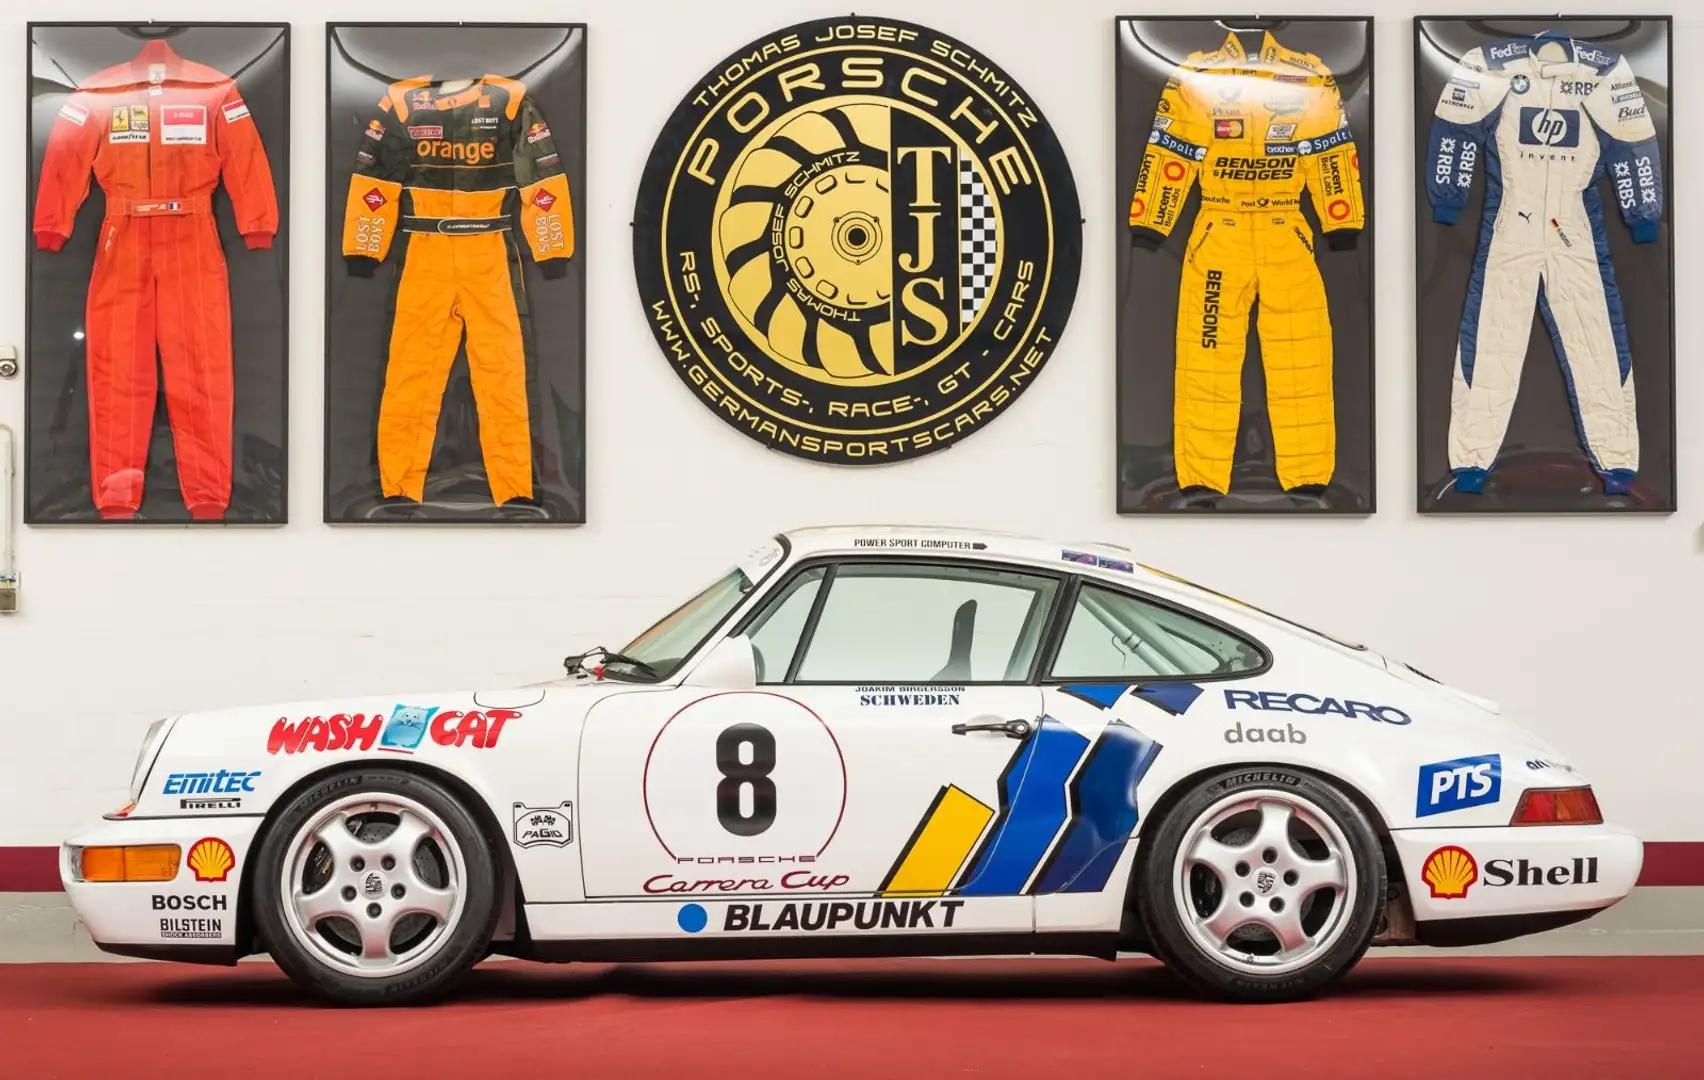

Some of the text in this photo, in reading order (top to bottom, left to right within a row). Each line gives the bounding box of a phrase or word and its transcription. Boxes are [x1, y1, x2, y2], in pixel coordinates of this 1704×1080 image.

[1490, 43, 1528, 60] FedEx
[692, 25, 1039, 129] THOMAS JOSEF SCHMITZ
[1575, 82, 1600, 96] RB
[687, 57, 1033, 194] PORSCHE
[1618, 104, 1646, 118] Bud
[1314, 130, 1348, 150] Spalt
[1537, 108, 1564, 146] hp
[417, 140, 495, 165] orange
[1162, 134, 1195, 157] Spalt
[1460, 141, 1477, 172] RBS
[1136, 153, 1156, 194] Lucent
[1215, 157, 1297, 169] BENSON
[1220, 169, 1294, 180] HEDGES
[1329, 155, 1344, 195] Lucent
[1436, 154, 1453, 185] RBS
[1635, 156, 1655, 187] RBS
[1153, 186, 1173, 226] Lucent
[1617, 178, 1636, 209] RBS
[353, 216, 371, 252] LOST
[367, 216, 386, 253] BOYS
[535, 216, 550, 253] BOYS
[549, 213, 564, 249] LOST
[771, 150, 861, 323] THOMAS JOSEF SCHMITZ
[1201, 269, 1223, 349] BENSONS
[937, 361, 971, 395] GT
[992, 259, 1035, 341] CARS
[652, 300, 1052, 457] WWW.GERMANSPORTSCARS.NET
[854, 538, 971, 550] POWER SPORT COMPUTER
[860, 694, 961, 707] SCHWEDEN
[1223, 689, 1413, 726] RECARO
[266, 709, 523, 756] WASH CAT
[1224, 722, 1307, 745] daab
[716, 722, 777, 837] 8
[1223, 770, 1298, 789] MICHELIN
[1430, 762, 1493, 805] PTS
[677, 855, 816, 864] PORSCHE
[1483, 856, 1600, 887] Shell
[643, 871, 850, 894] Carrera Cup
[152, 894, 228, 911] BOSCH
[724, 901, 965, 932] BLAUPUNKT
[160, 918, 222, 932] BILSTEIN
